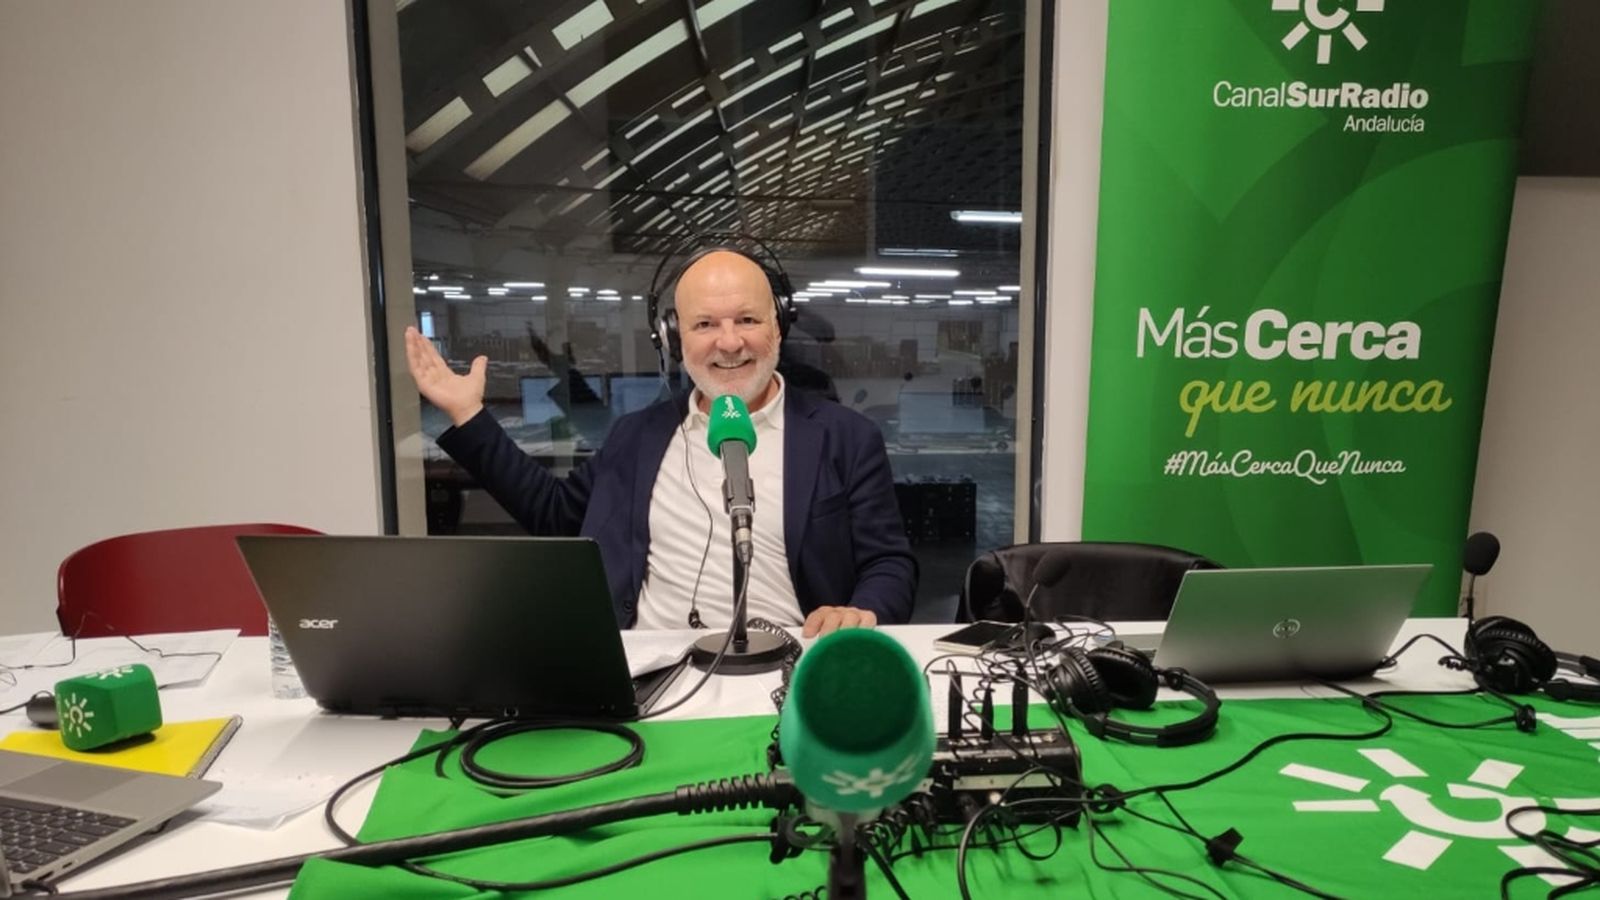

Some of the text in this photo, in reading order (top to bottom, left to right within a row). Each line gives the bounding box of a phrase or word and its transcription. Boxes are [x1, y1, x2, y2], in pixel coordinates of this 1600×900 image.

[1213, 80, 1429, 109] CanalSurRadio
[1343, 114, 1425, 132] Andalucía
[1136, 305, 1422, 360] Más Cerca
[1179, 380, 1452, 438] que nunca
[1164, 449, 1406, 485] #MásCercaQueNunca
[299, 619, 338, 629] acer
